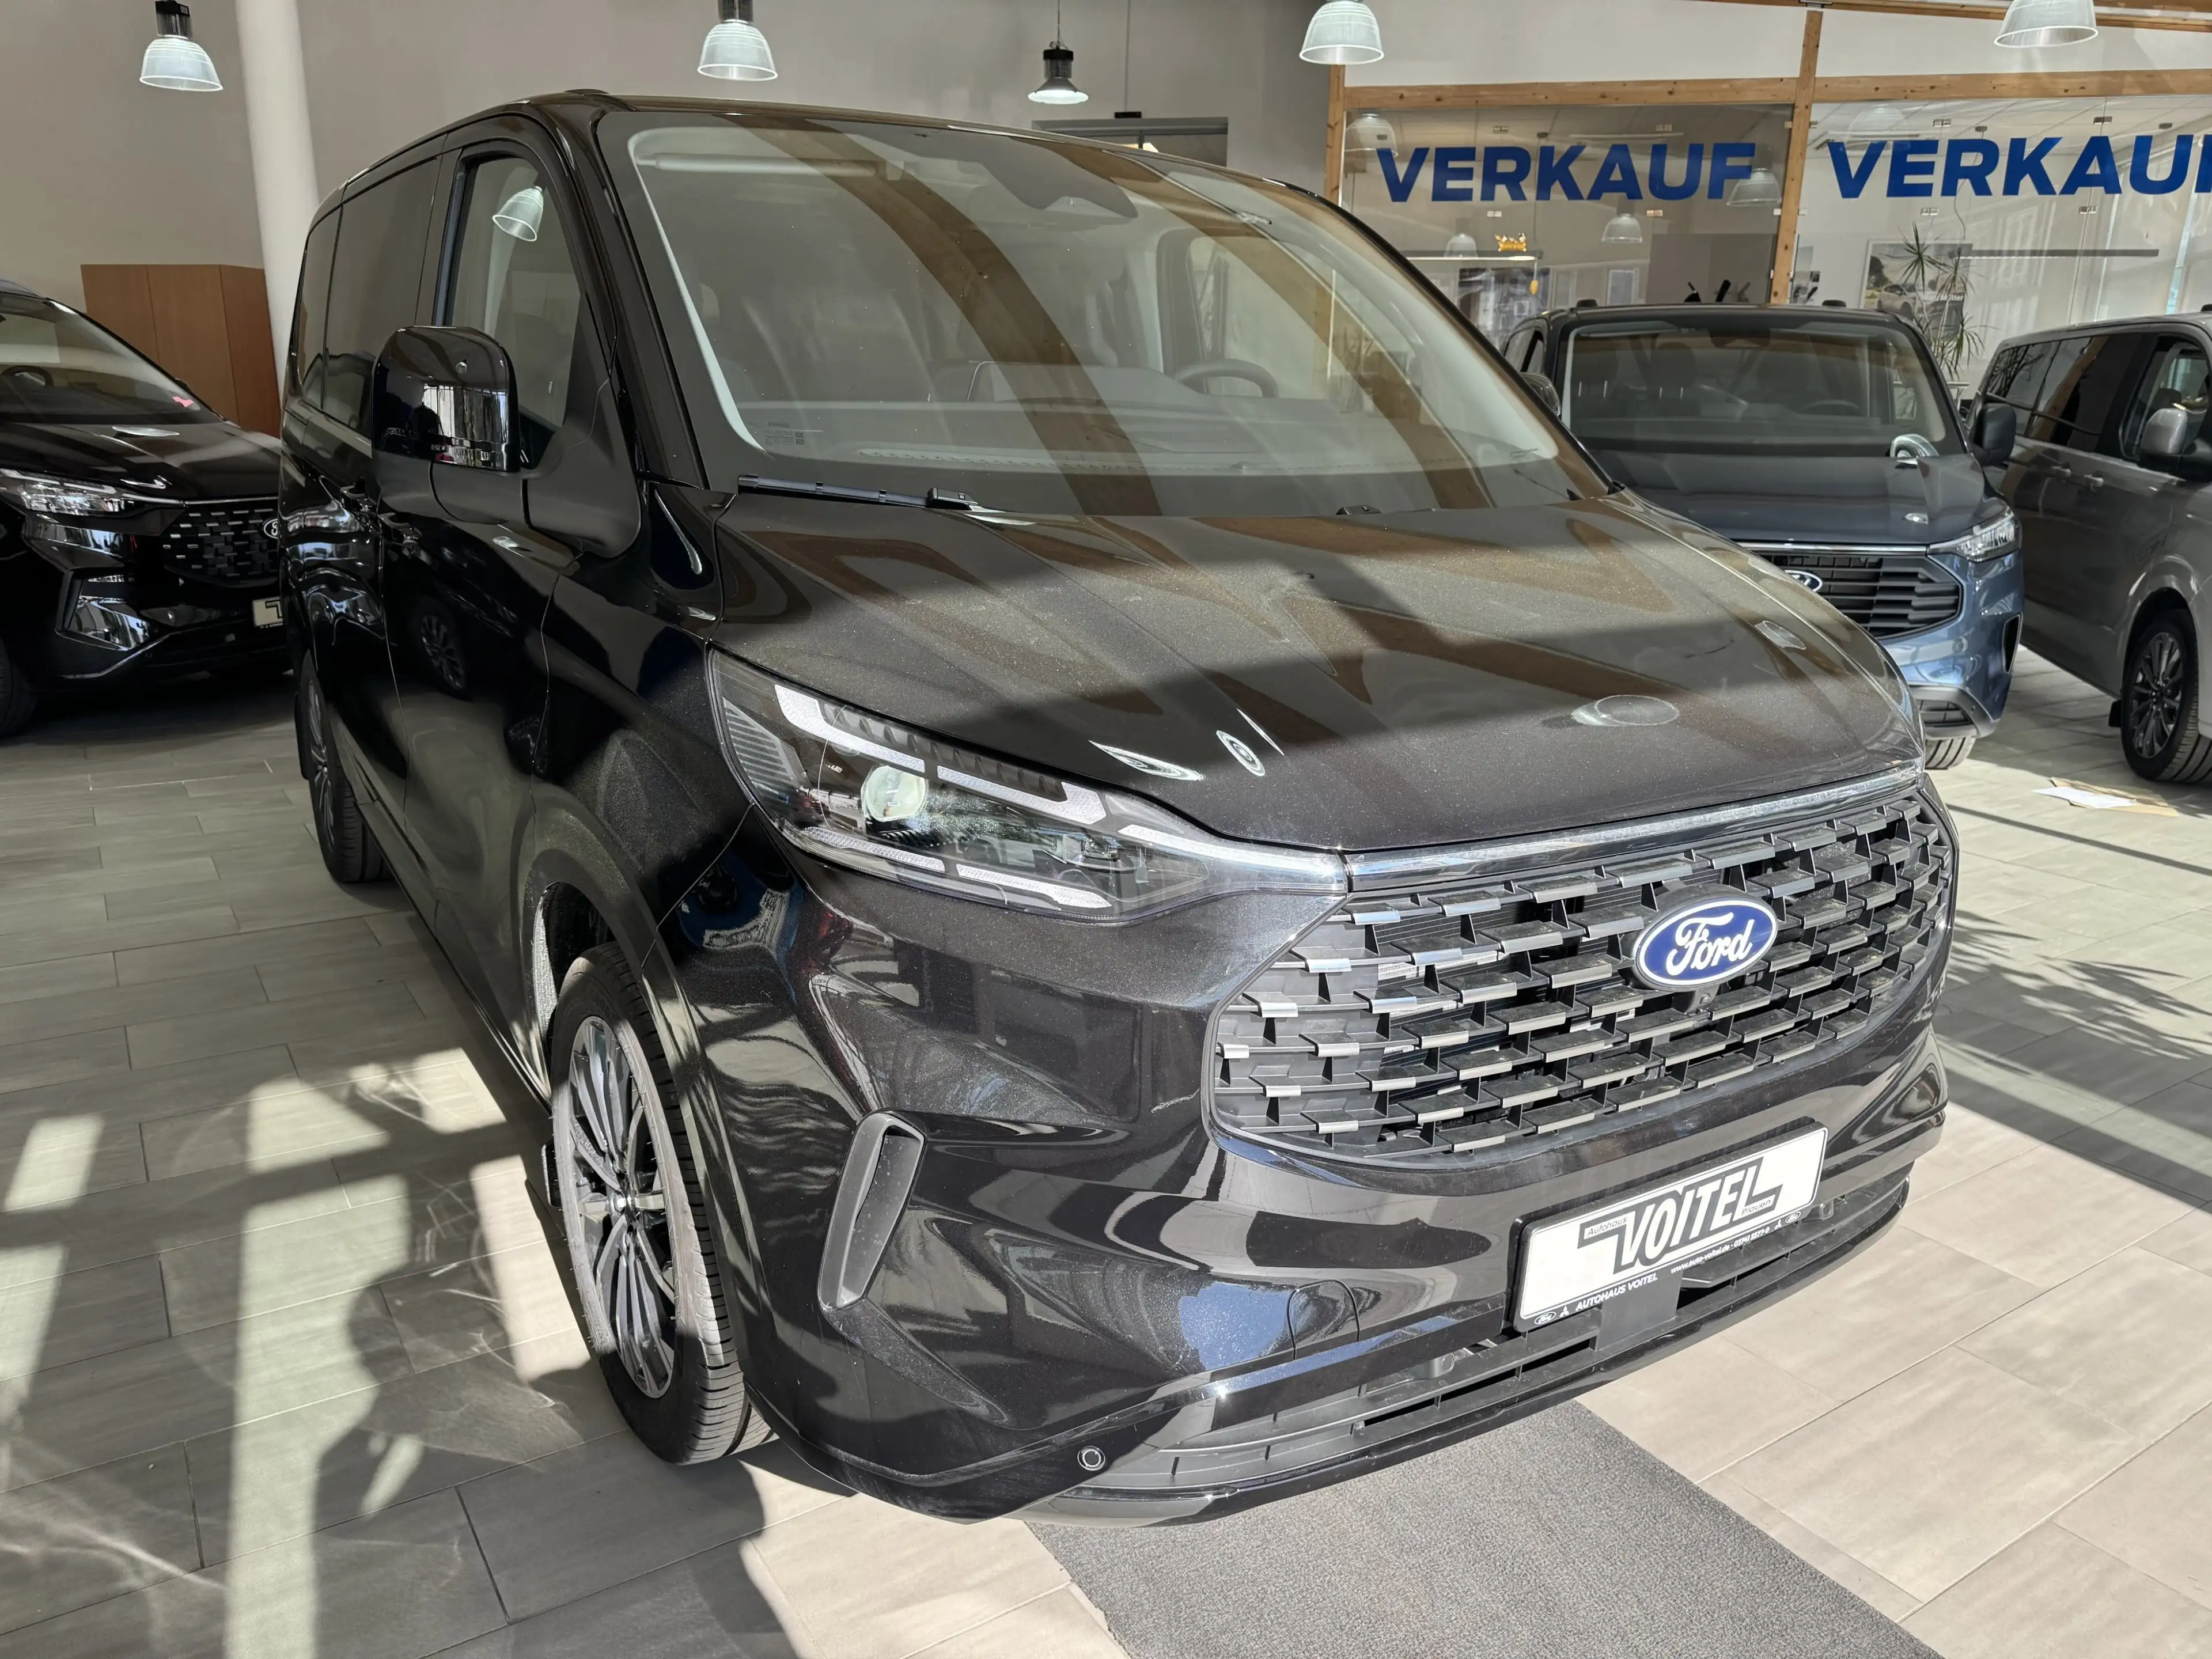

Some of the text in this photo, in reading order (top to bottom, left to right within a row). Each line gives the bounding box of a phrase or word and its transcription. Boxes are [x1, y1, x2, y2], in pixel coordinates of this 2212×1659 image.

[1376, 142, 1756, 203] VERKAUF
[1665, 911, 1755, 976] Ford
[1587, 1217, 1627, 1236] Autohaus
[1618, 1164, 1760, 1267] VOITEL
[1742, 1198, 1773, 1217] Plauen
[1575, 1272, 1658, 1311] AUTOHAUS VOITEL
